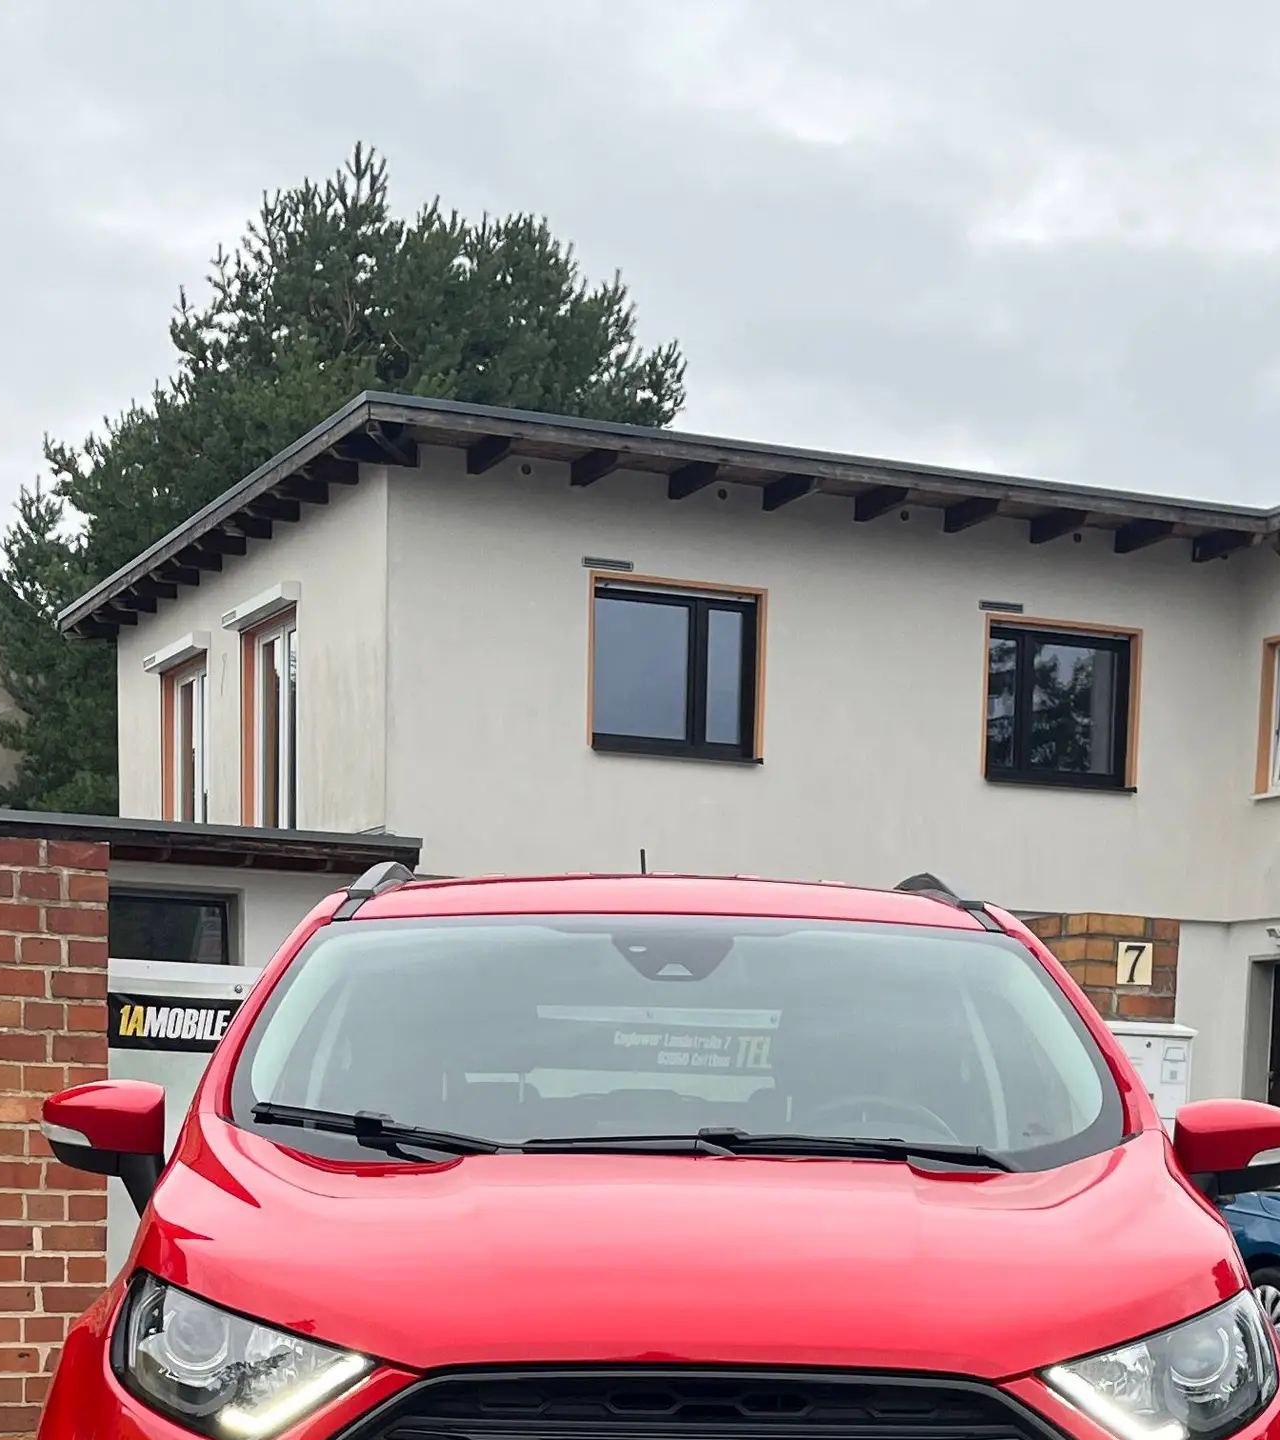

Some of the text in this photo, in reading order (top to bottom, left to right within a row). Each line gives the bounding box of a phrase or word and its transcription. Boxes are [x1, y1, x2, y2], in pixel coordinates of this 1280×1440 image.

[1124, 945, 1146, 983] 7
[119, 1004, 231, 1041] 1AMOBILE
[723, 1036, 732, 1050] 7
